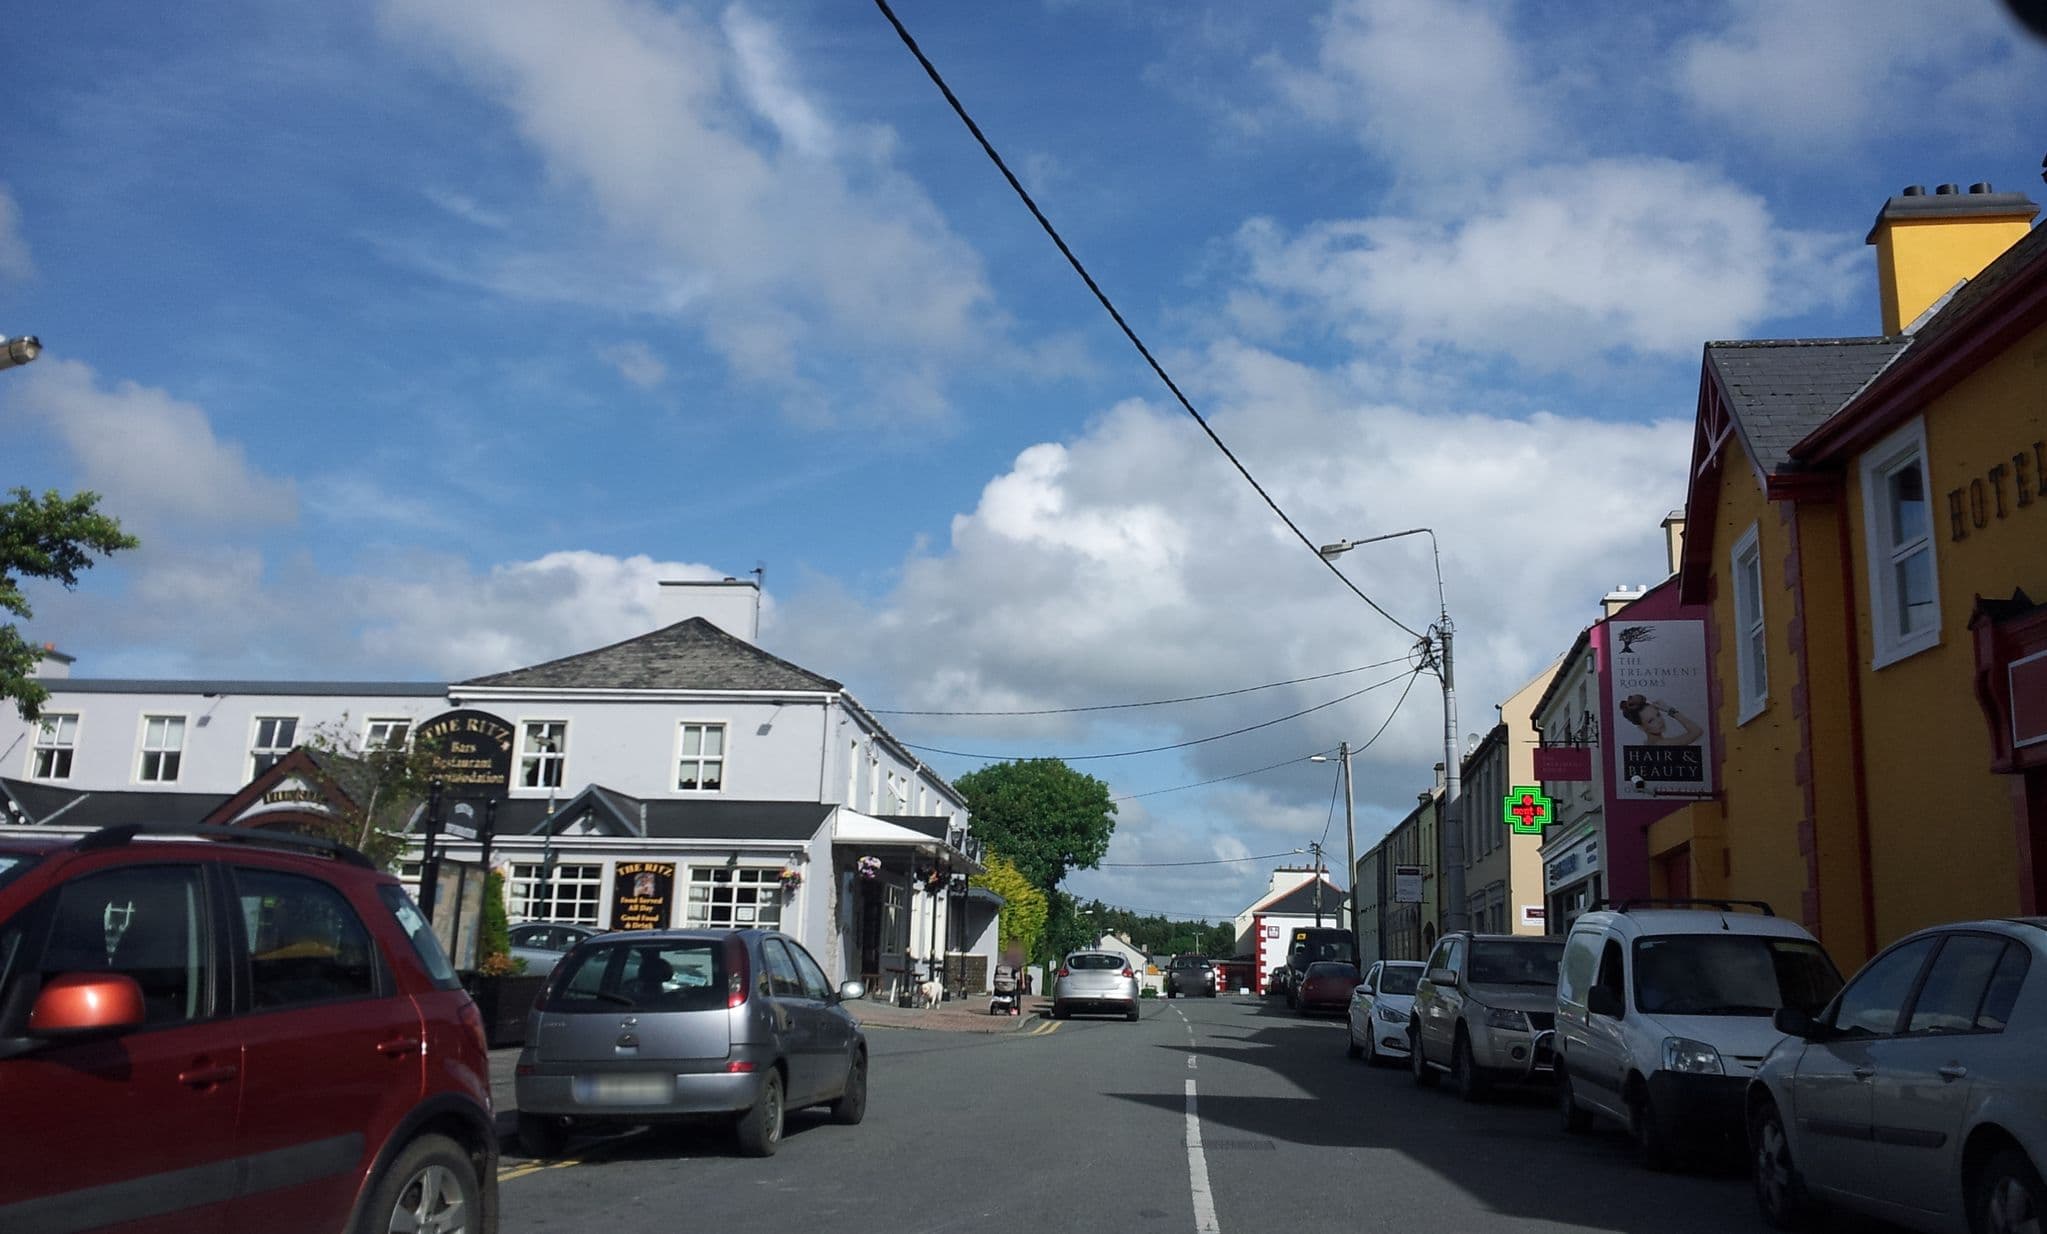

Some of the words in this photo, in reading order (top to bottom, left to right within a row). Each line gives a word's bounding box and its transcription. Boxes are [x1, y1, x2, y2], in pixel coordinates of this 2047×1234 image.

[1948, 440, 2047, 542] HOTEL
[1618, 657, 1640, 666] THE
[1618, 667, 1697, 678] TREATMENT
[1619, 679, 1667, 689] ROOMS
[421, 719, 460, 739] THE
[467, 718, 510, 741] RITZ
[1629, 750, 1673, 761] HAIR
[1682, 751, 1698, 763] &
[1629, 765, 1698, 777] BEAUTY
[618, 863, 641, 876] THE
[644, 863, 673, 876] RITZ
